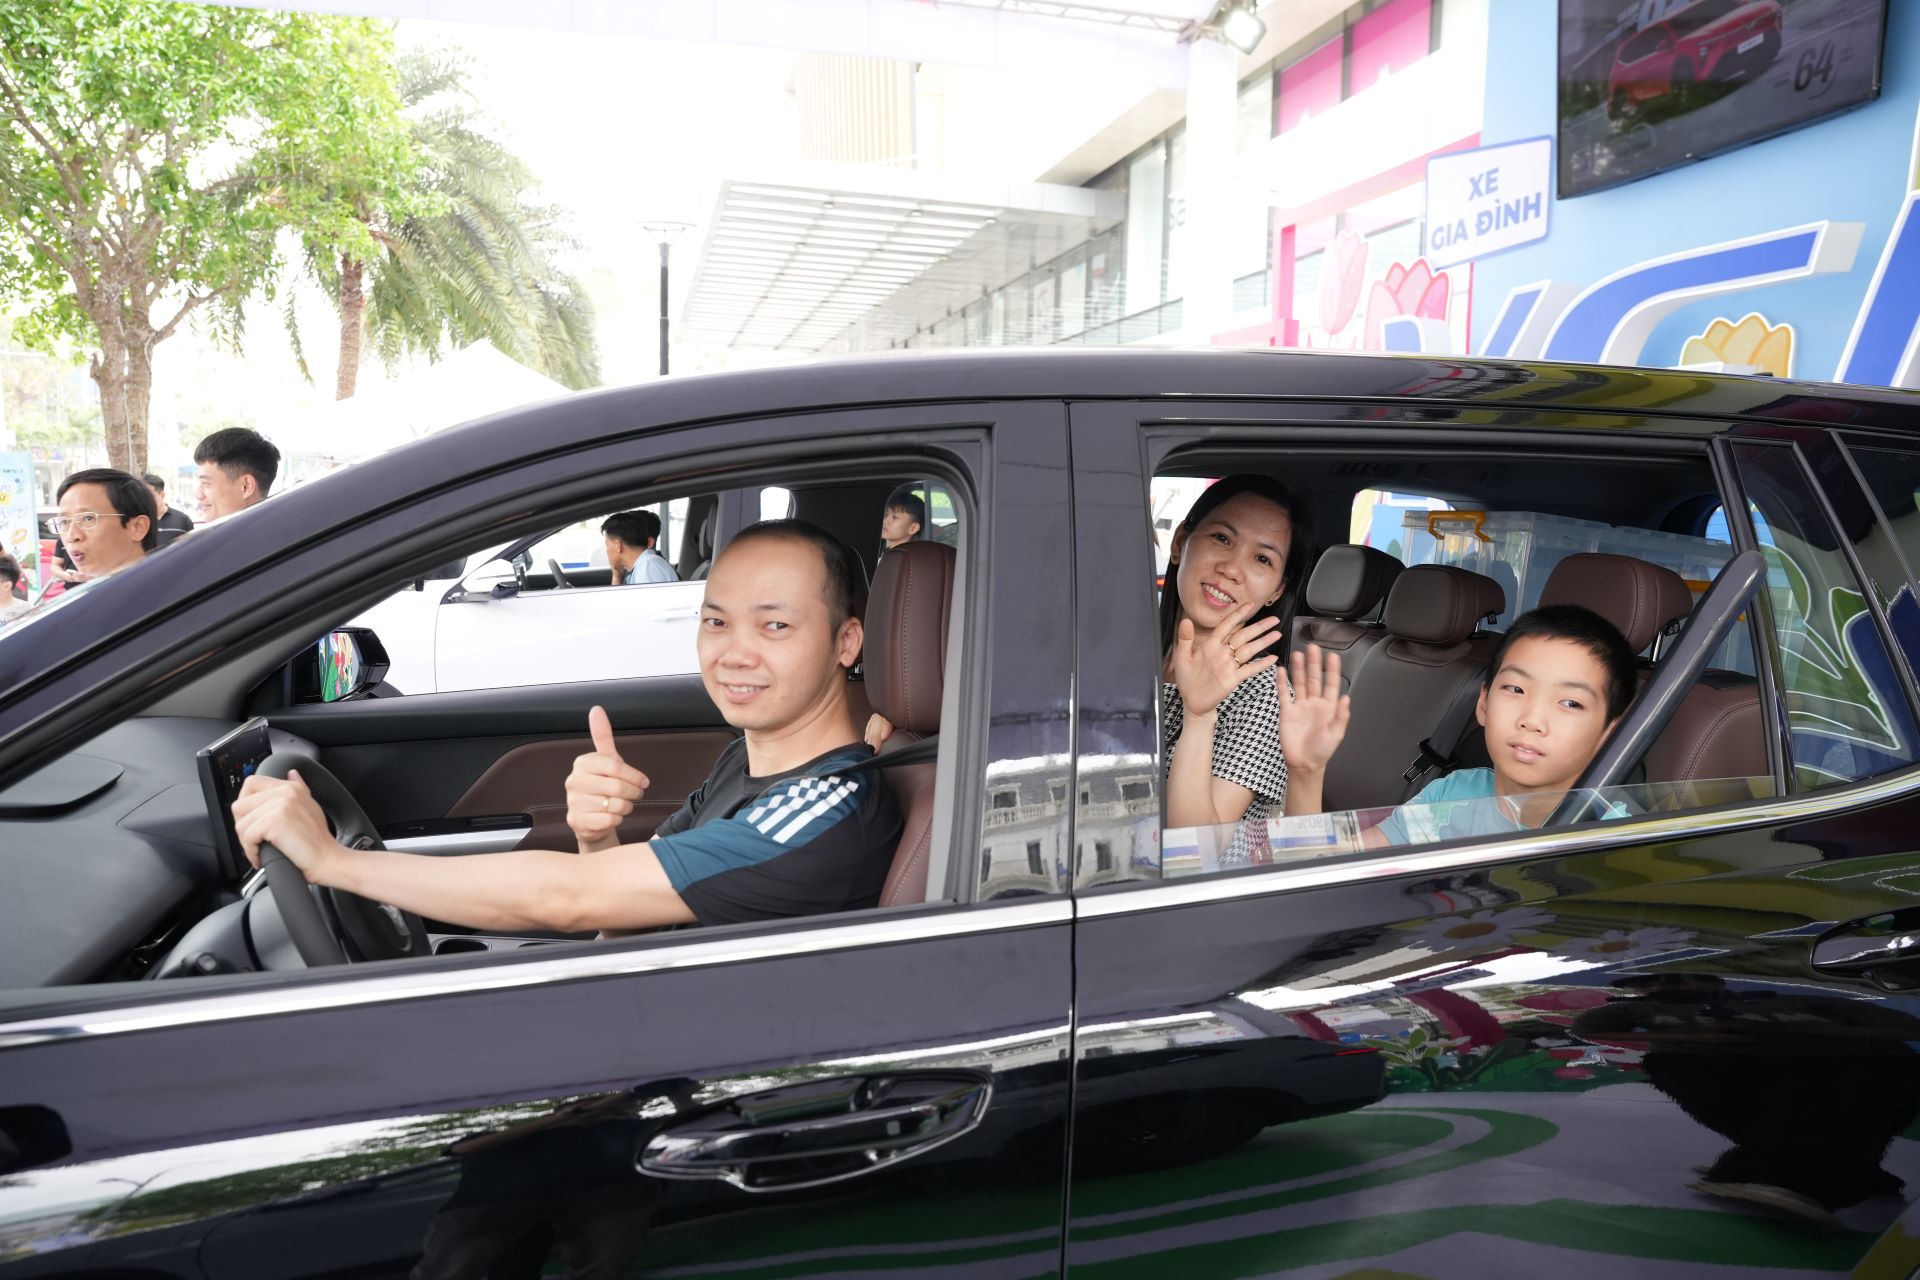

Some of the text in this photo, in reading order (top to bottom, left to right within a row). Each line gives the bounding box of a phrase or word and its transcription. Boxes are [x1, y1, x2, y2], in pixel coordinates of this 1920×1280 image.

[1794, 40, 1834, 92] 64
[1468, 167, 1499, 201] XE
[1431, 192, 1541, 250] GIA ĐÌNH
